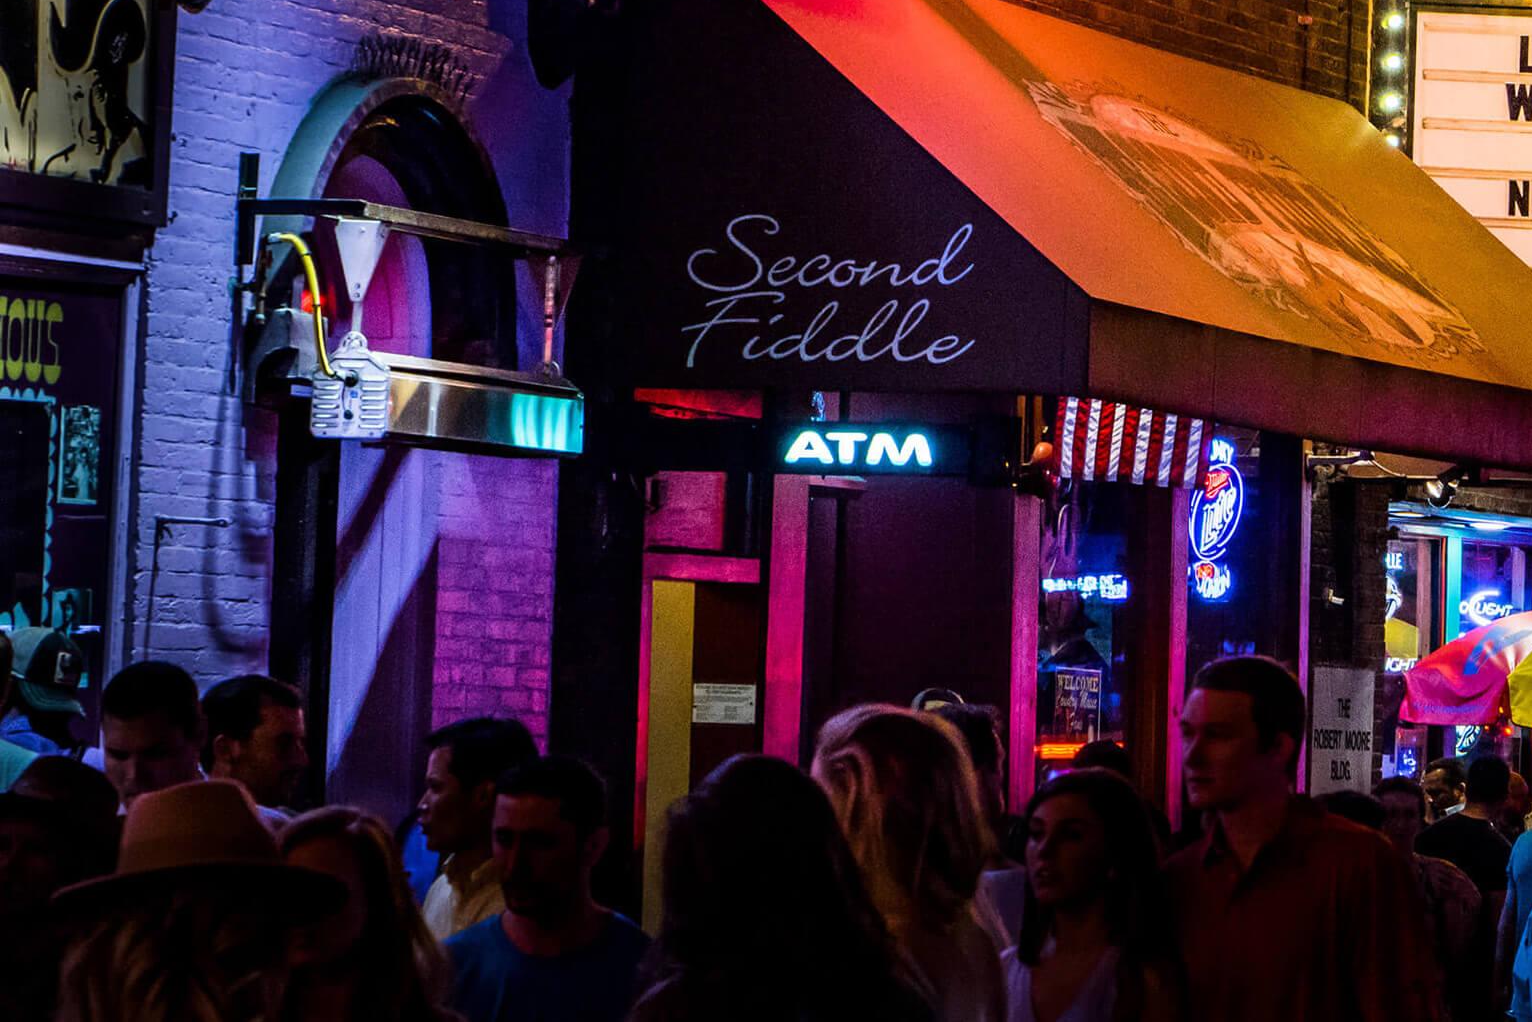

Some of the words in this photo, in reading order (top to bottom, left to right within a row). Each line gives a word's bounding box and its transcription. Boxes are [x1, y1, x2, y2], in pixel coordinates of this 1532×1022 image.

[686, 213, 974, 292] Second
[681, 290, 975, 369] Fiddle
[784, 431, 933, 466] ATM
[1057, 674, 1099, 693] WELCOME
[1338, 698, 1351, 718] THE
[1313, 729, 1342, 750] ROBERT
[1345, 729, 1371, 751] MOORE
[1330, 760, 1351, 780] BLDG
